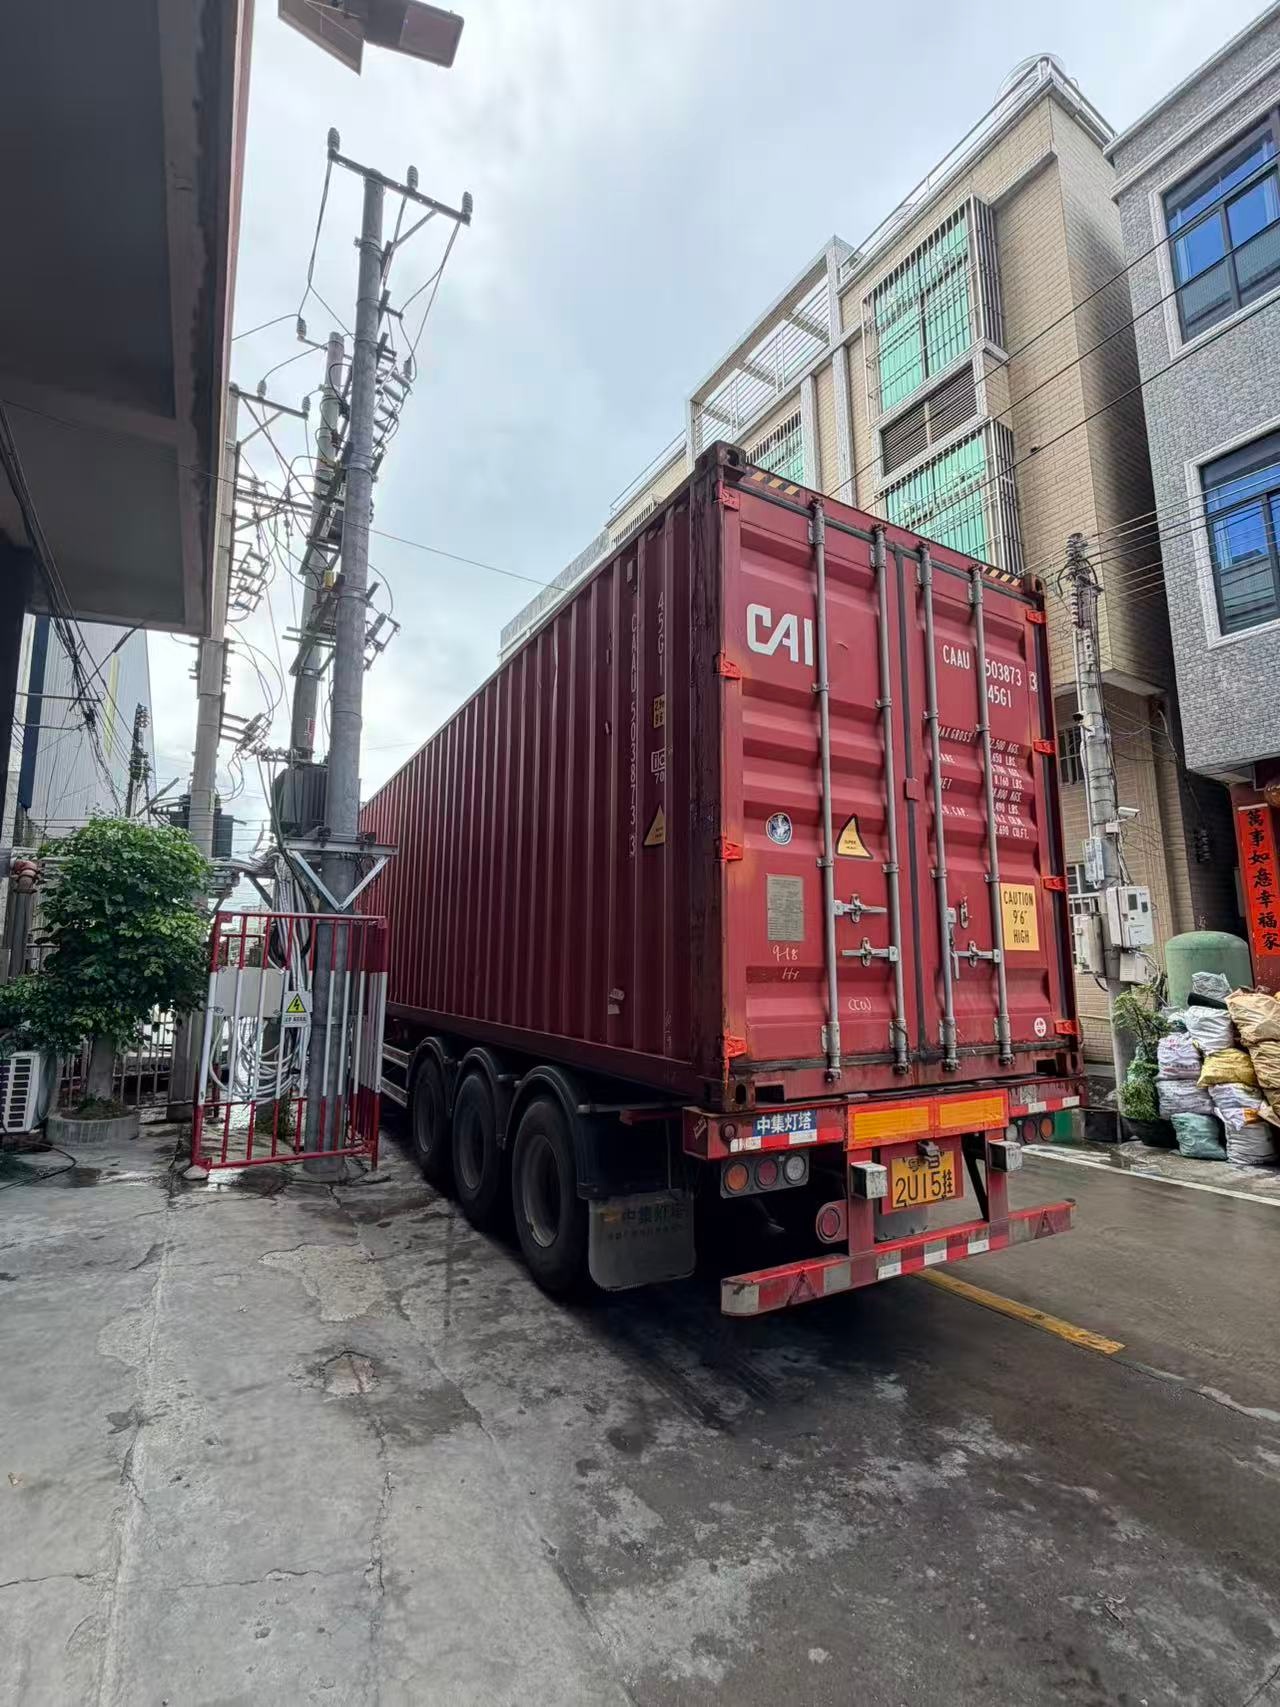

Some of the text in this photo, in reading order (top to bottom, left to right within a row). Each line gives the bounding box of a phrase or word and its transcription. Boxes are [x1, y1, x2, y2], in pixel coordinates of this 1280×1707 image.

[746, 603, 813, 666] CAI
[942, 644, 1037, 691] CAAU 503873 3
[987, 684, 1012, 709] 45G1
[1003, 891, 1033, 907] CAUTION
[1013, 929, 1029, 944] HIGH
[756, 1111, 812, 1135] 中集灯塔
